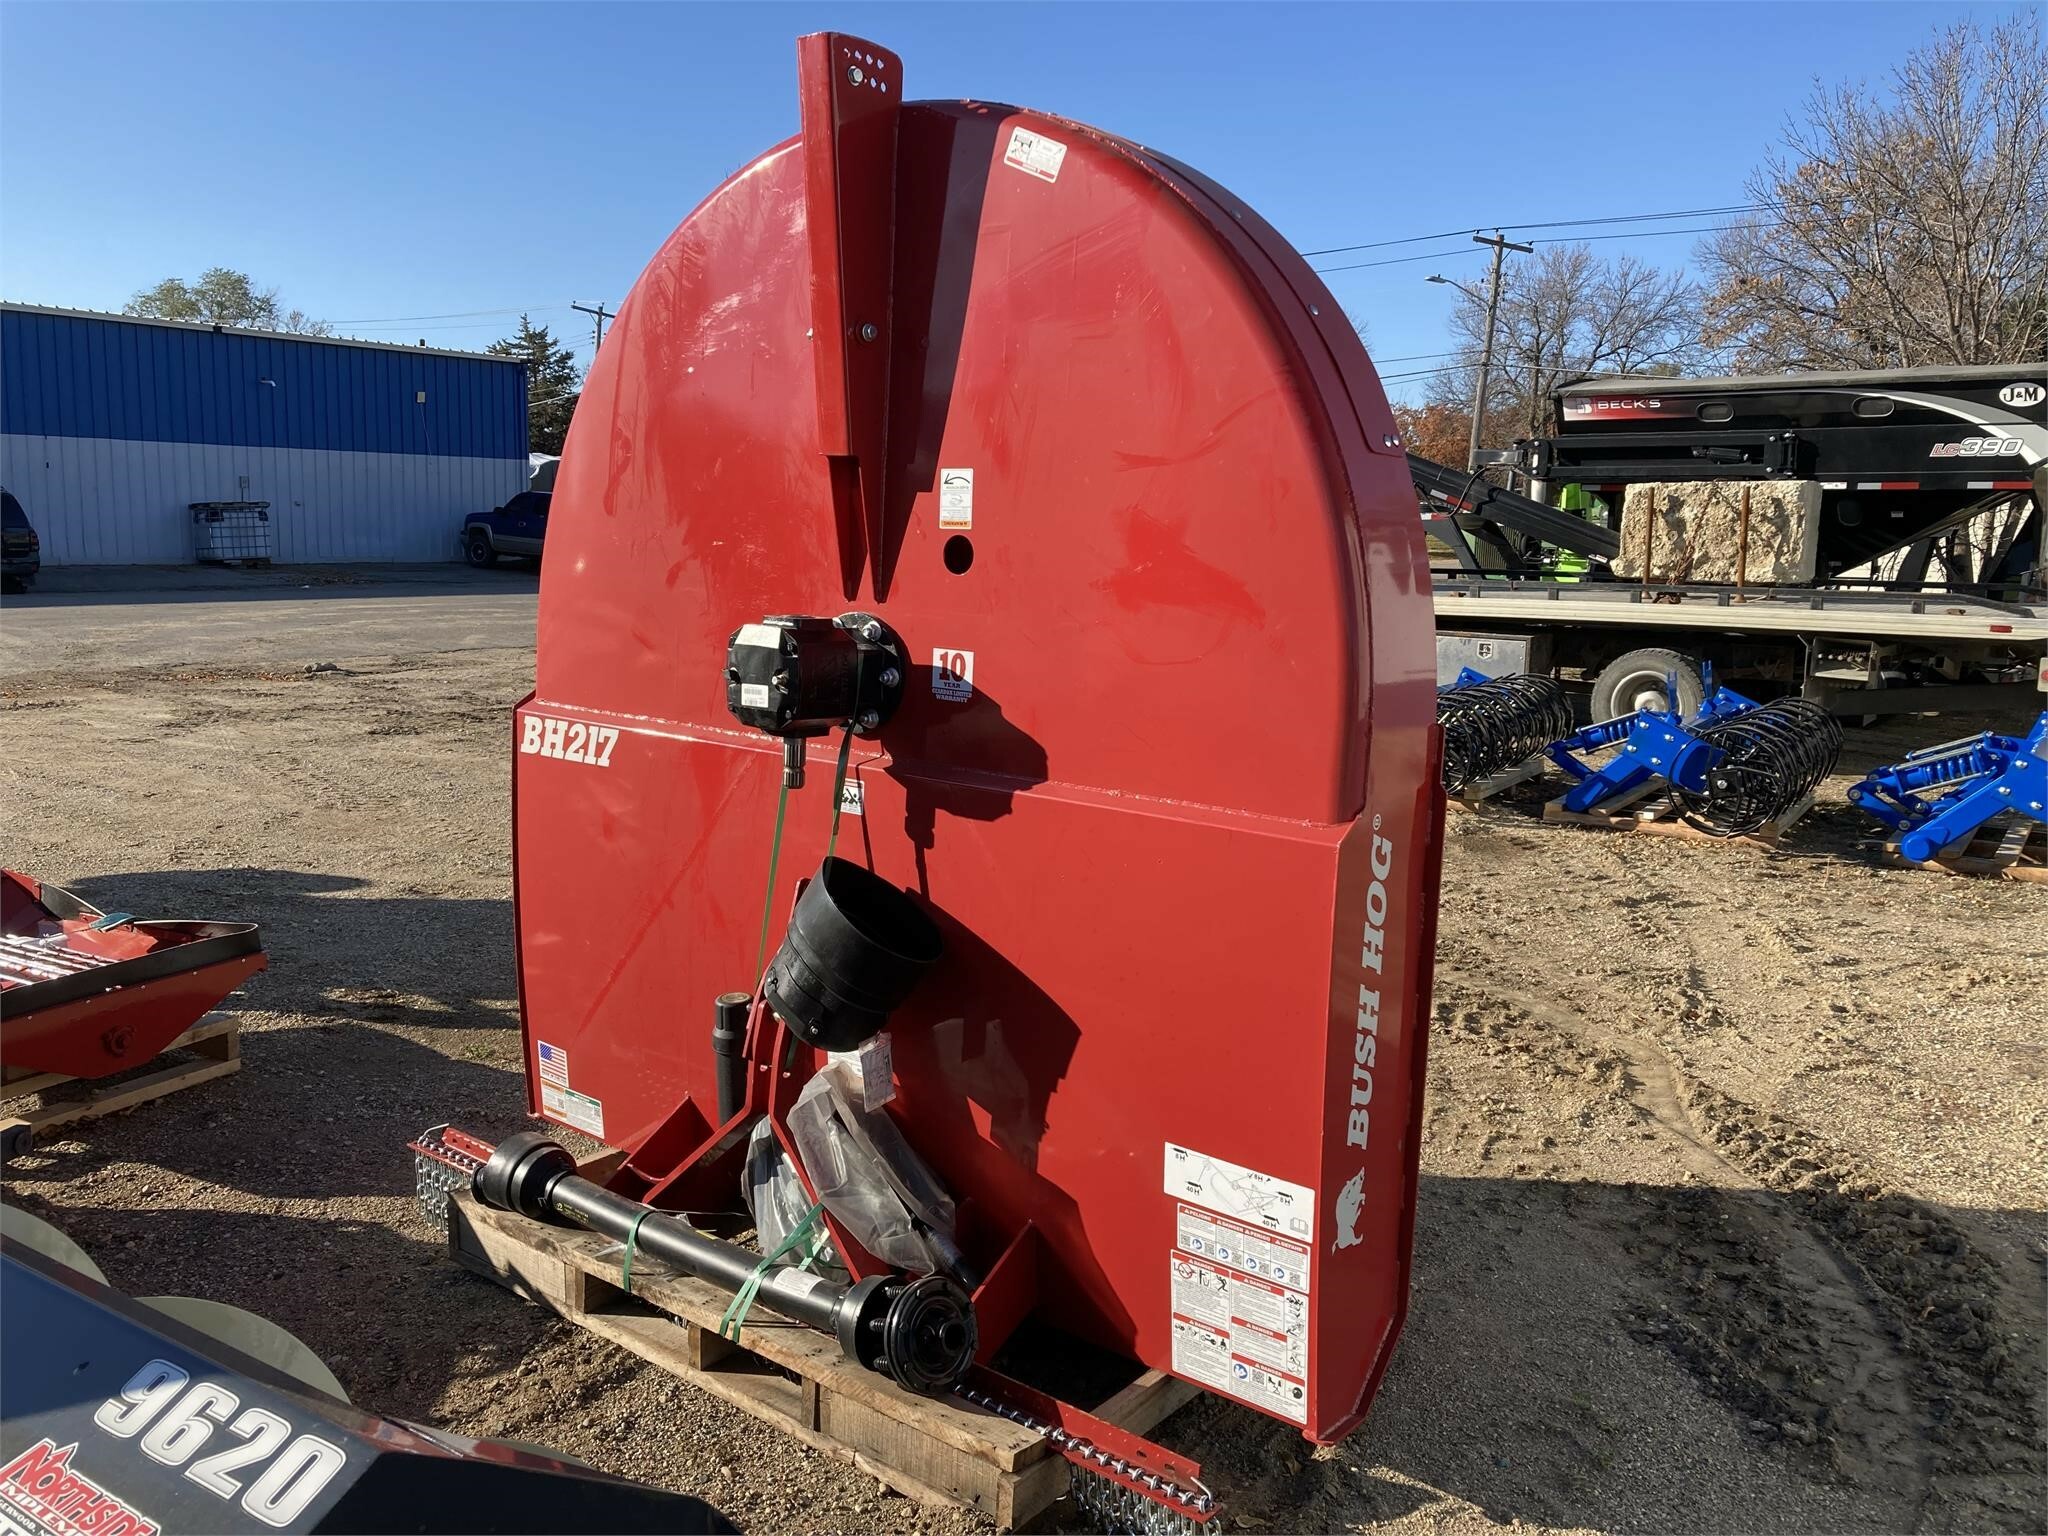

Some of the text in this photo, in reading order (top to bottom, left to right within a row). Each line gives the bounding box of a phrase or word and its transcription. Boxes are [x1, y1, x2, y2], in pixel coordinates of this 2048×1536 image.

[2003, 387, 2038, 402] J&M
[1597, 399, 1661, 409] BECK'S
[939, 651, 966, 682] 10
[520, 715, 620, 768] BH217
[1346, 834, 1393, 1151] BUSH HOG
[1193, 1260, 1215, 1272] DANGER
[1250, 1279, 1272, 1291] DANGER
[1194, 1321, 1216, 1333] DANGER
[1252, 1324, 1274, 1336] DANGER
[1261, 1364, 1283, 1377] DANGER
[94, 1359, 347, 1528] 9620
[0, 1481, 85, 1536] IMPLEM
